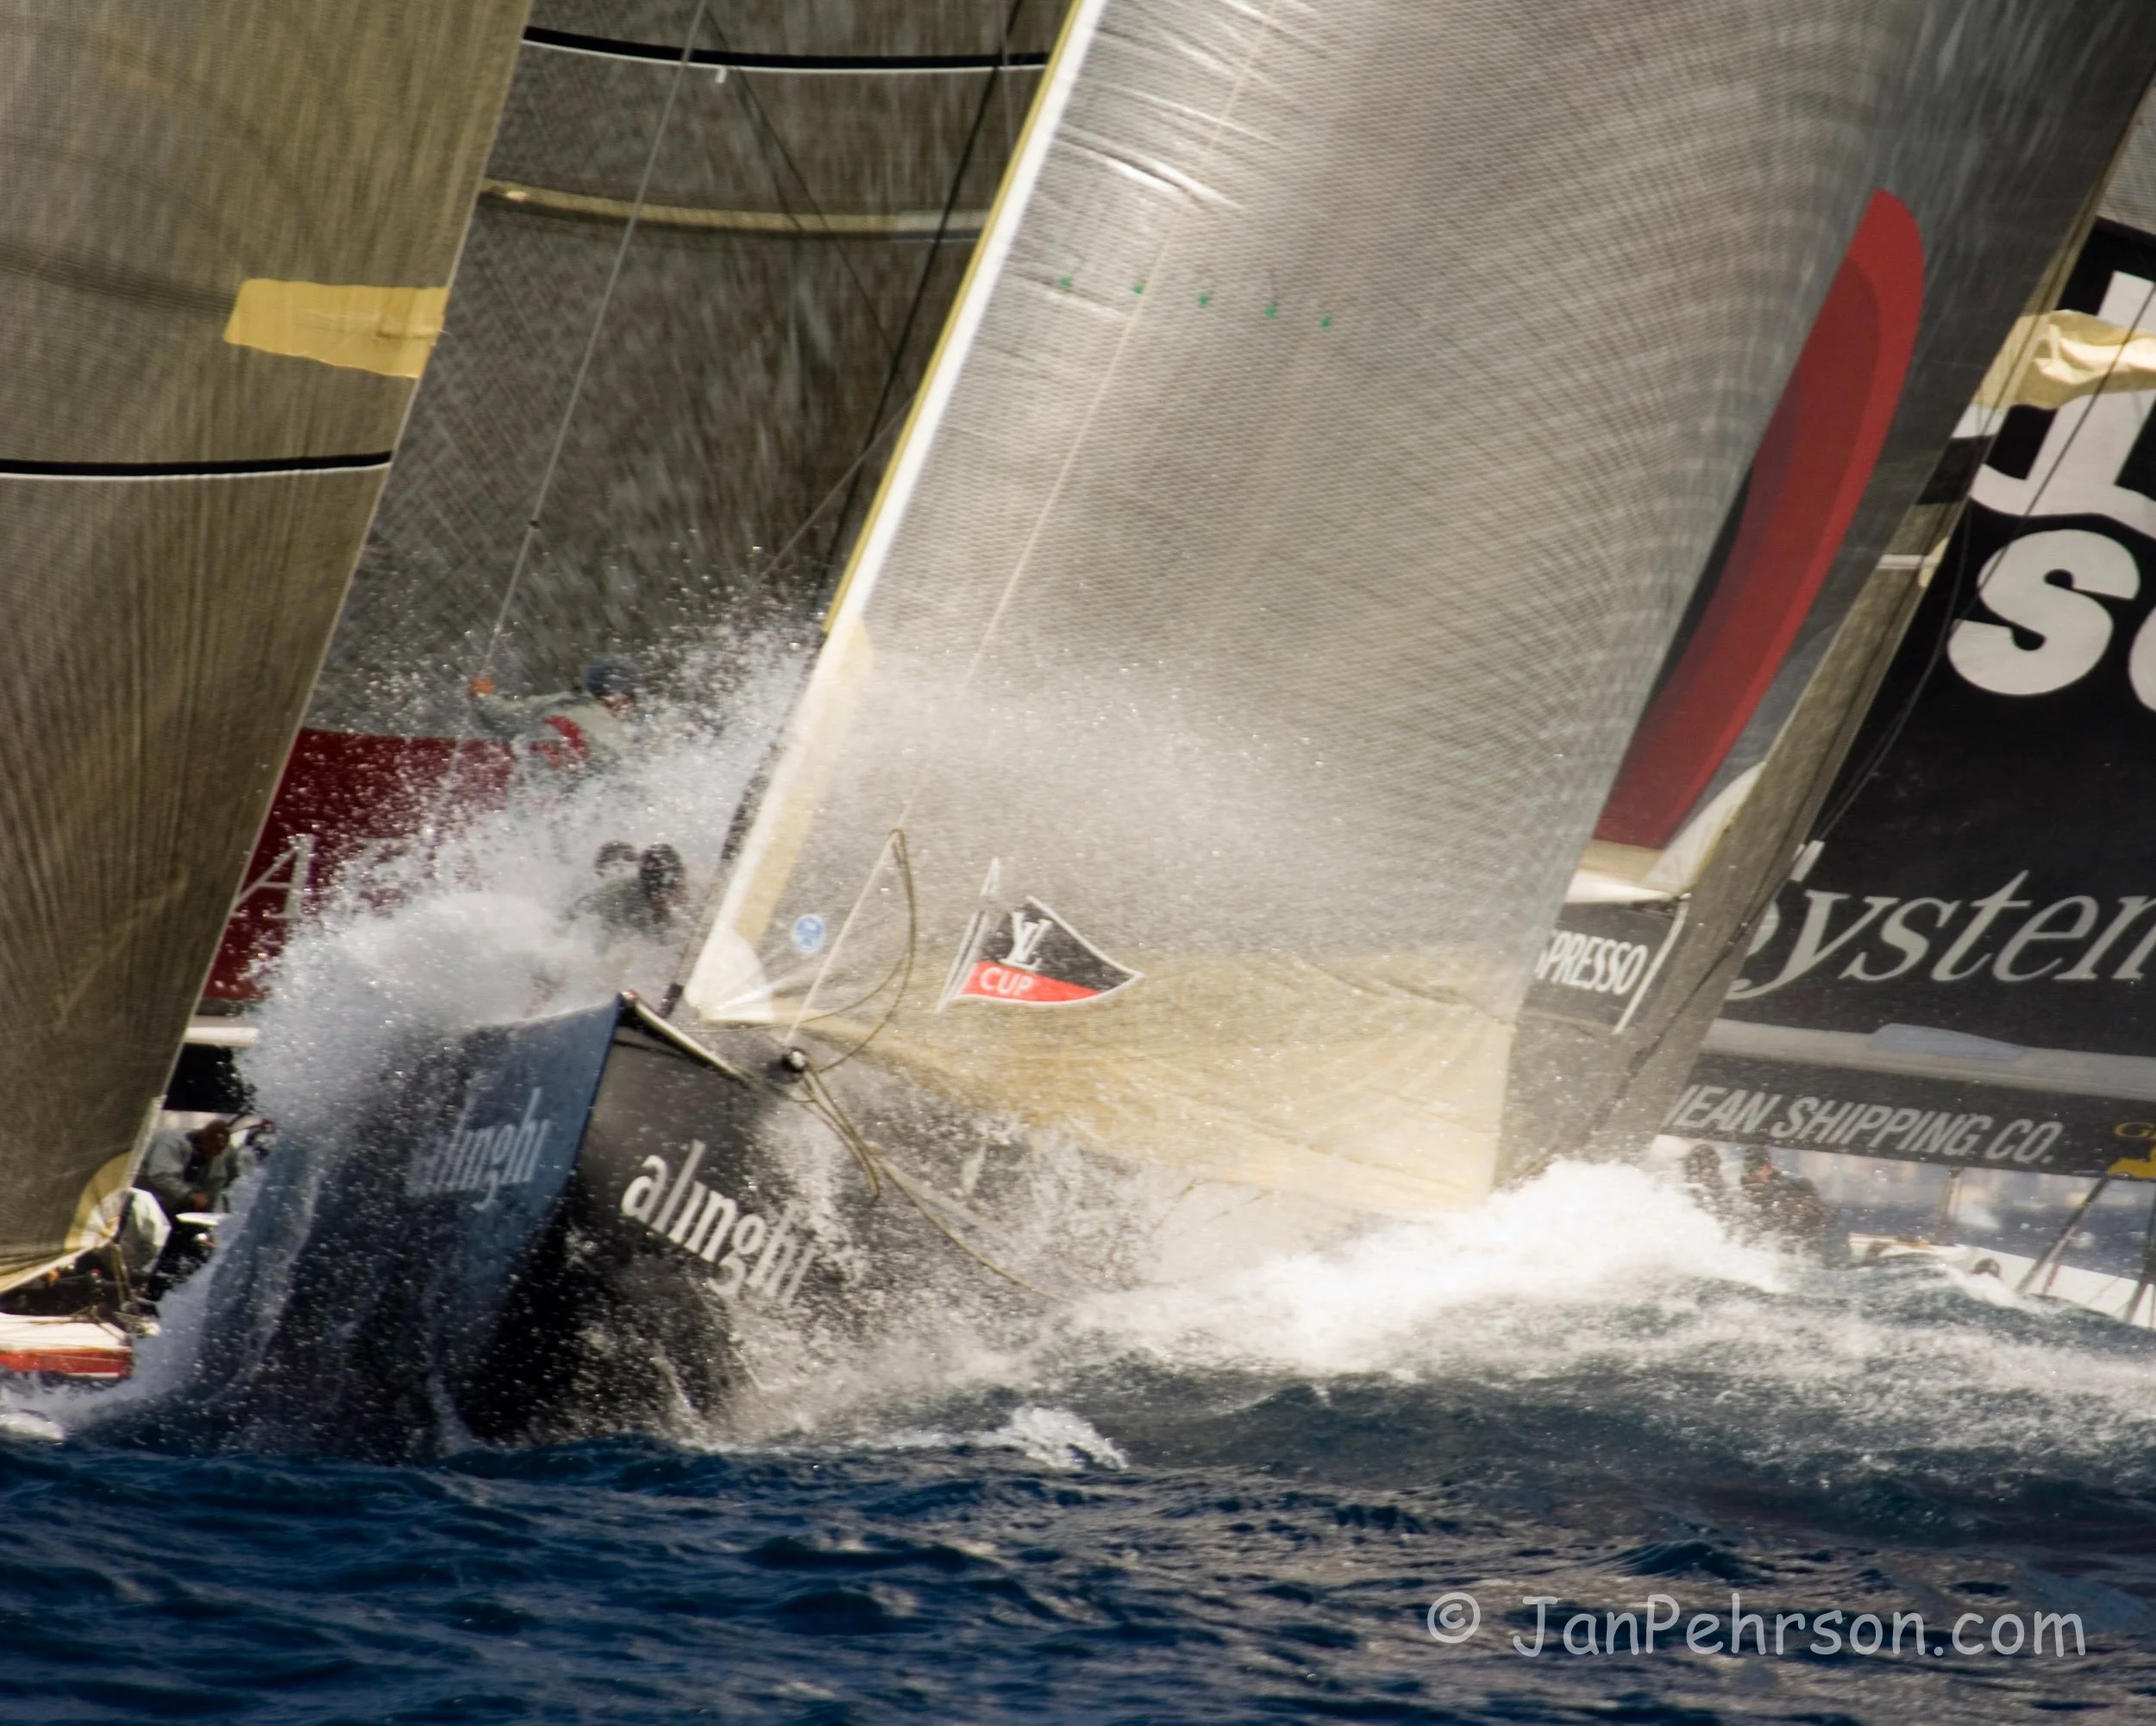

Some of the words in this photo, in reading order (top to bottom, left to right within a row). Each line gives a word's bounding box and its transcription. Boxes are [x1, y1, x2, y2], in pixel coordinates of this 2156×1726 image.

[980, 967, 1034, 995] CUP
[1534, 929, 1649, 995] PRESSO
[1770, 1096, 1995, 1157] SHIPPING
[1985, 1118, 2064, 1164] CO.
